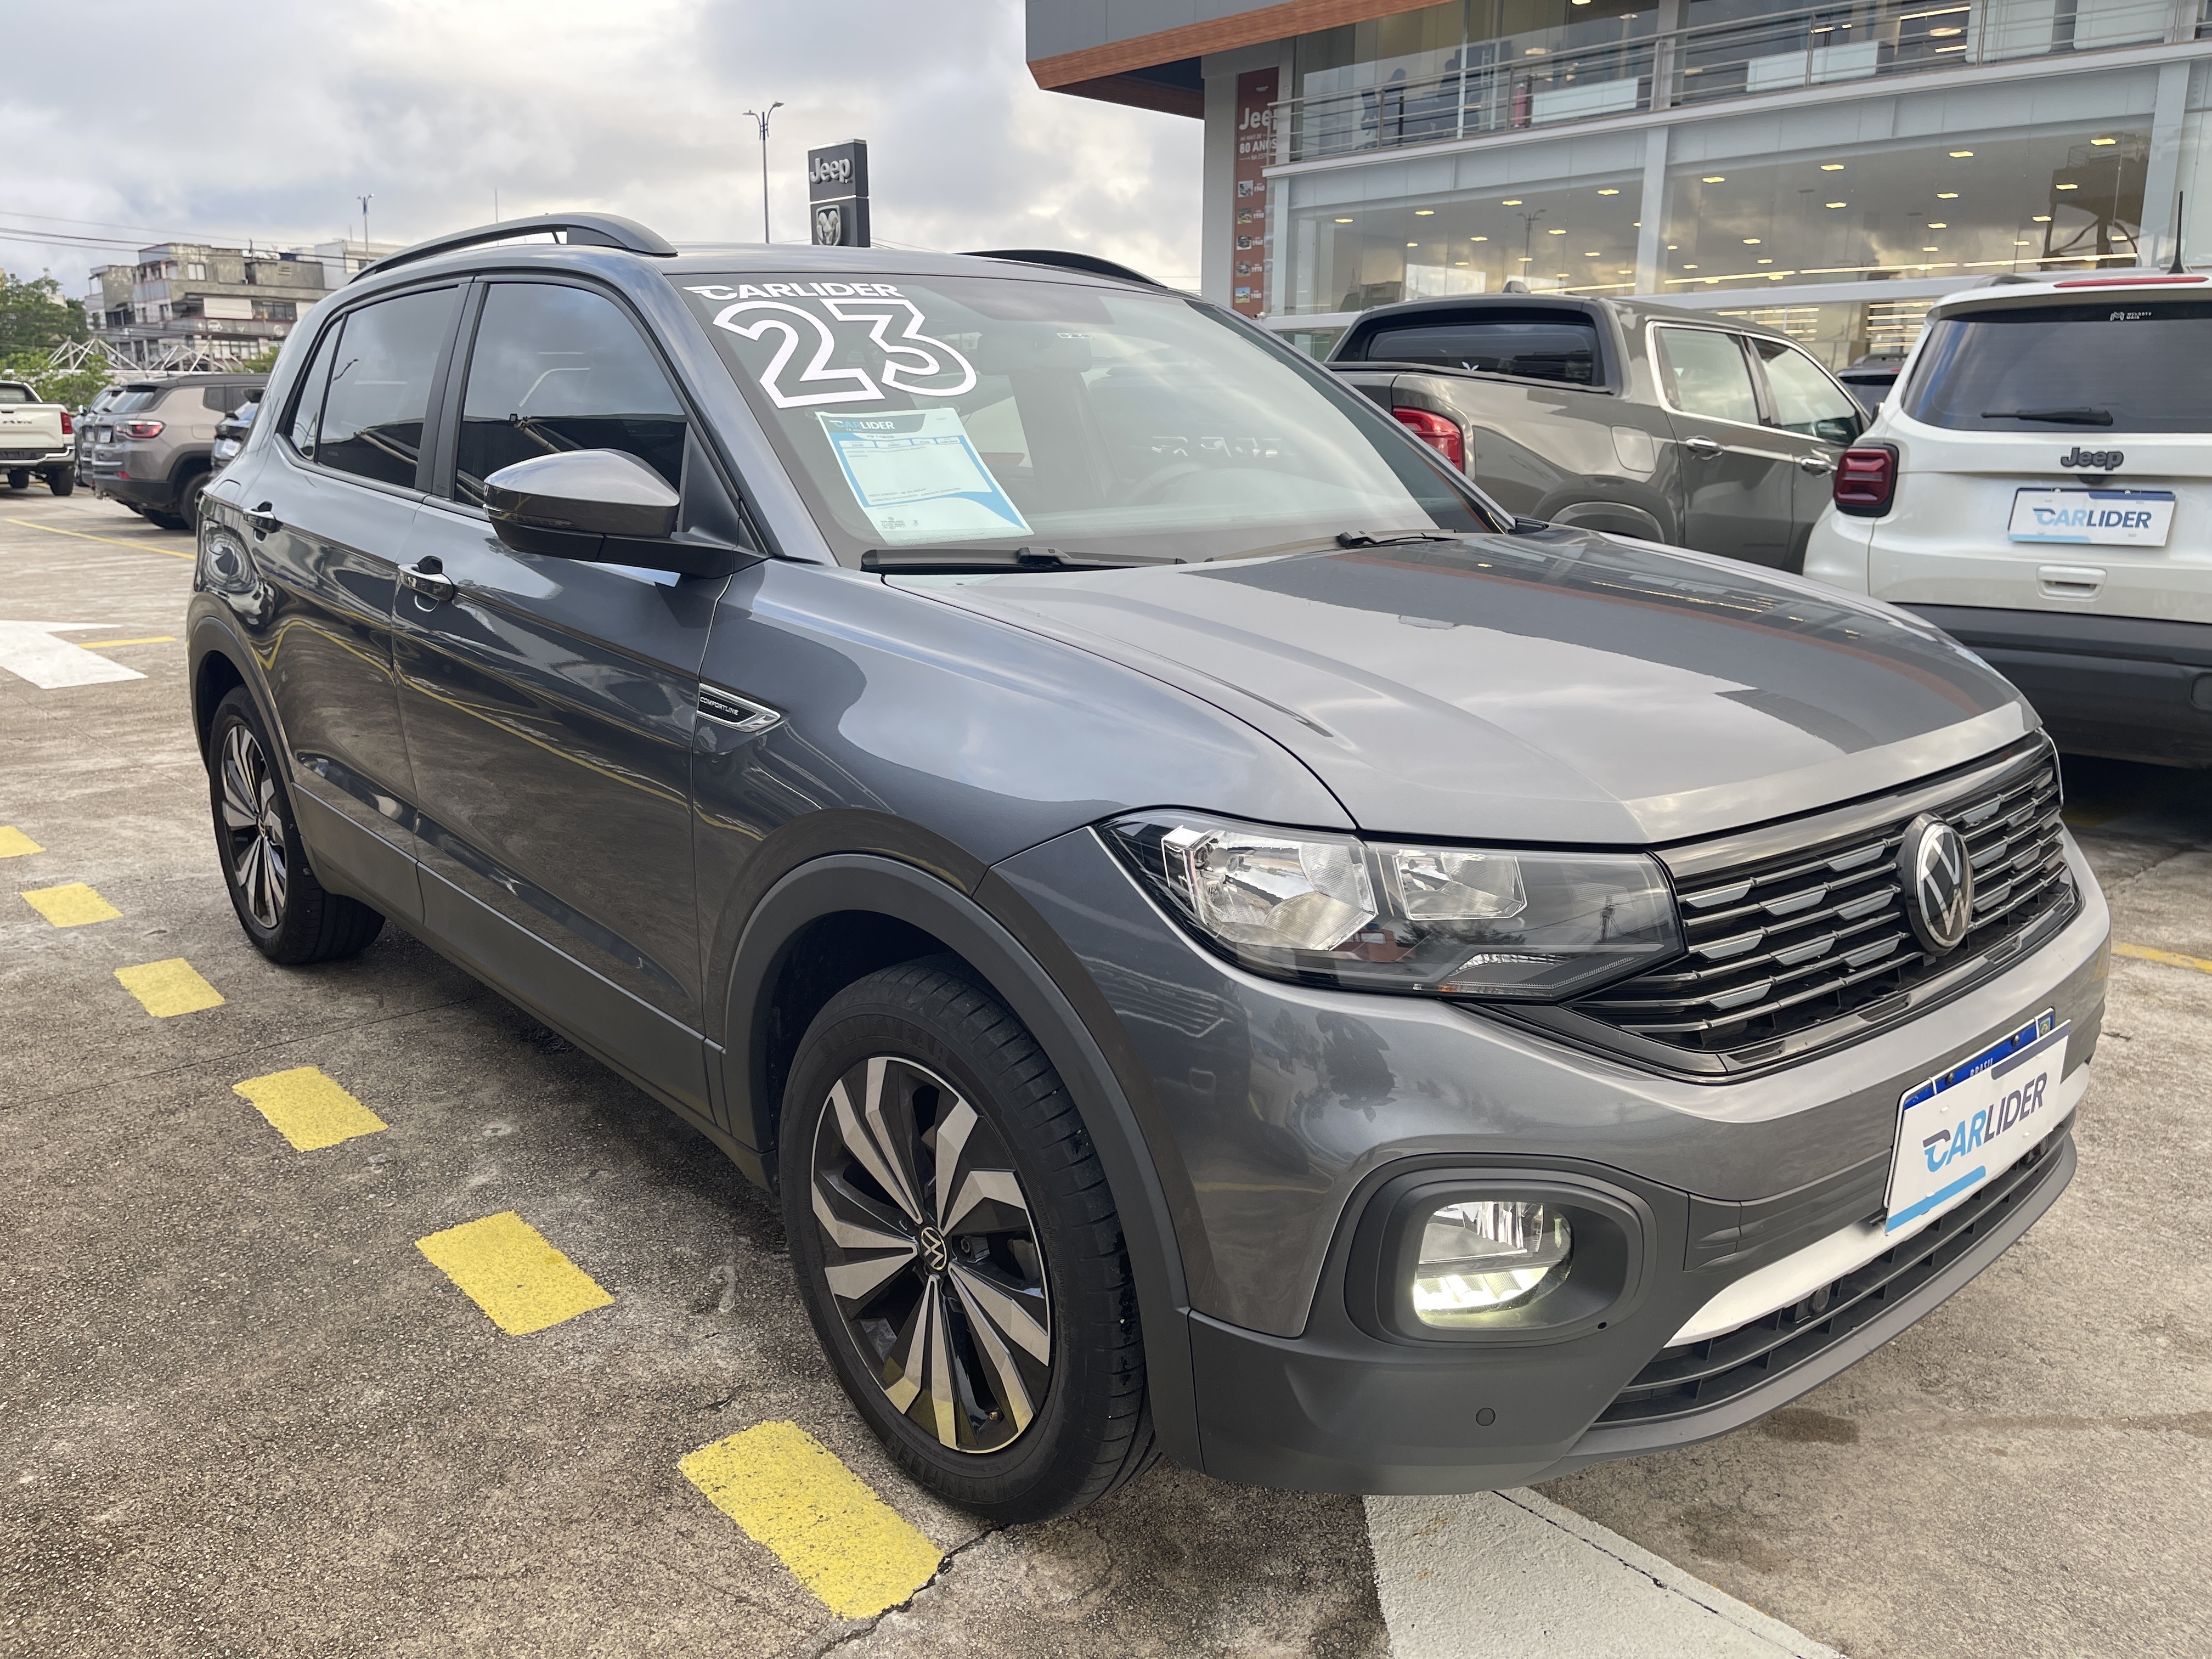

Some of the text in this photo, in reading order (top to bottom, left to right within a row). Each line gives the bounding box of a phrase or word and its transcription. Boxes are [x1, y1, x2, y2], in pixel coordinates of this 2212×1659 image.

[1239, 138, 1277, 154] 80 ANOS
[809, 157, 851, 184] Jeep
[682, 283, 905, 301] CARLIDER
[713, 298, 977, 408] 23
[829, 420, 895, 430] CARLIDER
[2061, 447, 2124, 471] Jeep
[2032, 507, 2152, 529] CARLIDER
[700, 696, 739, 716] COMFORTLINE
[819, 1015, 950, 1066] GOODYEAR
[1922, 1072, 2047, 1172] CARLIDER
